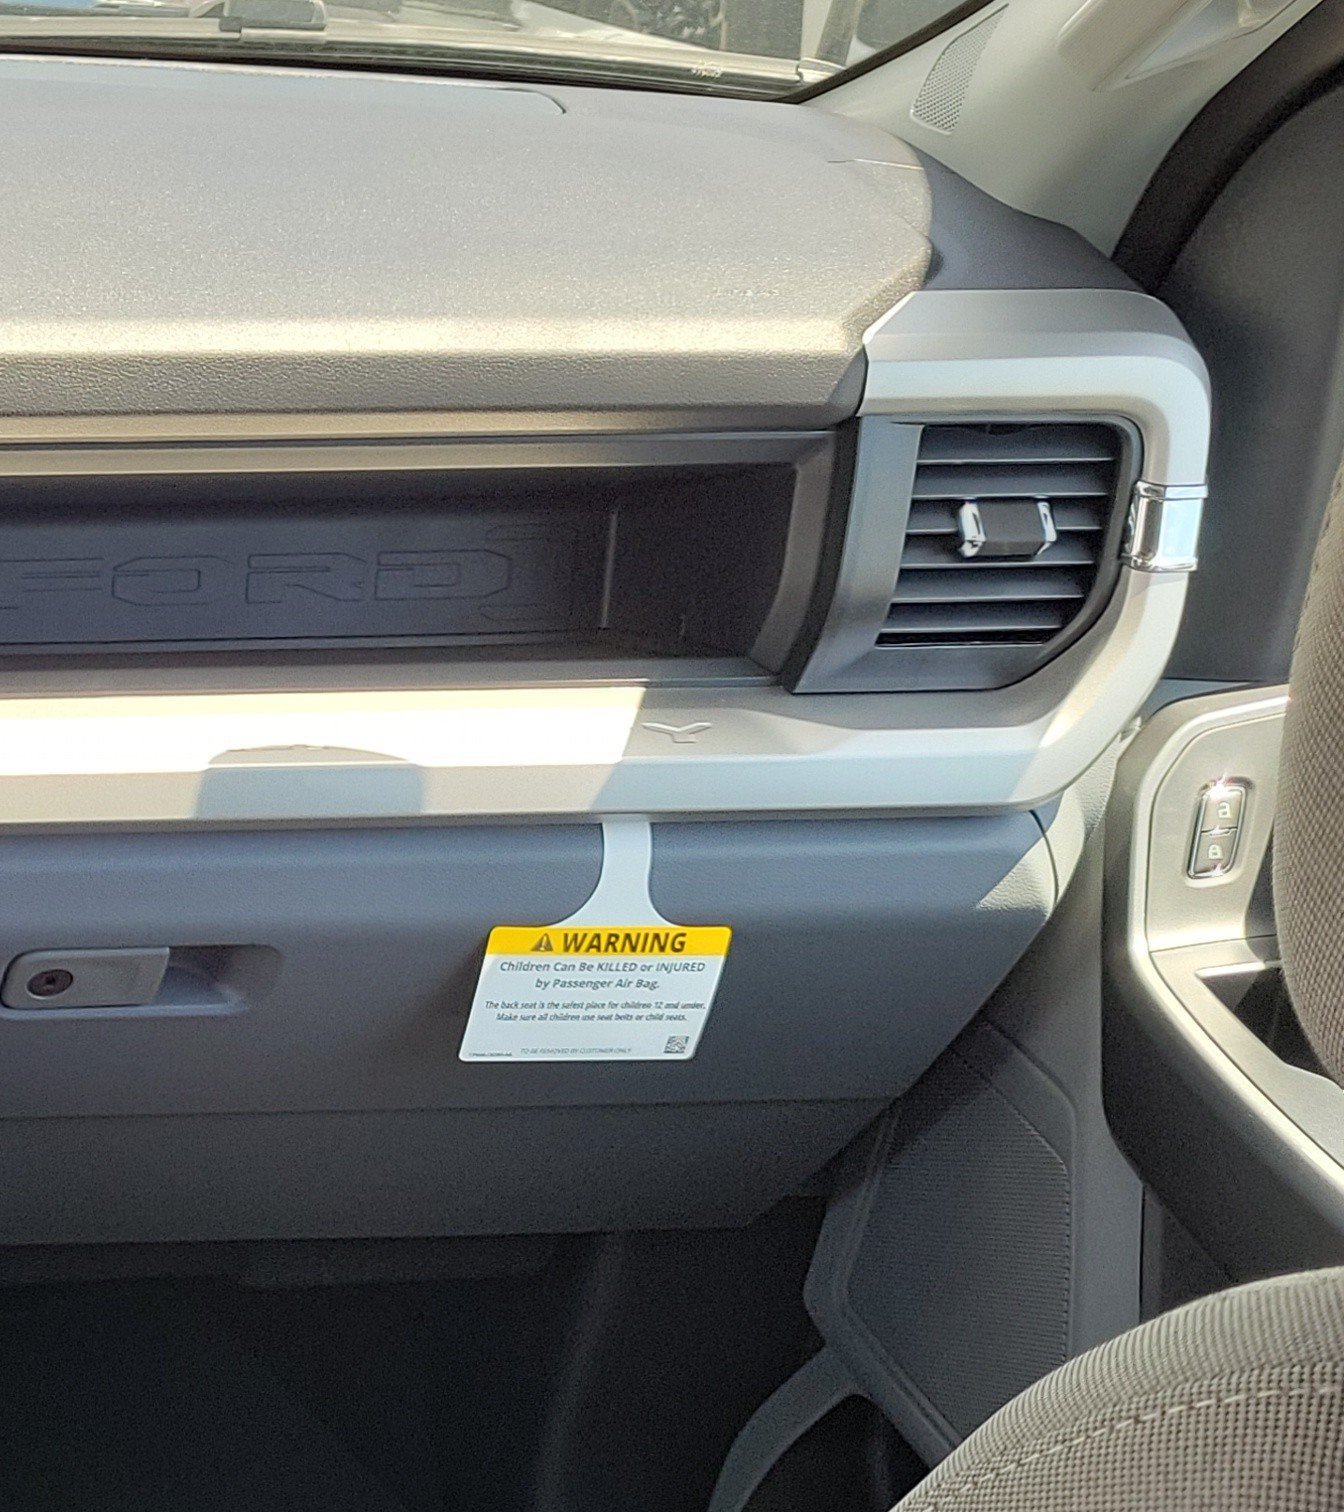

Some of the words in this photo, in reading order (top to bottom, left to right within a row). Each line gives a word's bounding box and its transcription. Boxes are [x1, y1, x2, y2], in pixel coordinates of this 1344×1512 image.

[562, 932, 687, 953] WARNING
[500, 961, 550, 972] Children
[553, 962, 577, 972] Can
[579, 962, 594, 972] Be
[596, 962, 637, 972] KILLED
[639, 964, 654, 972] or
[656, 962, 706, 973] INJURED
[534, 979, 550, 990] by
[553, 979, 613, 990] Passenger
[615, 979, 633, 989] Air
[635, 979, 660, 990] Bag.
[485, 1001, 499, 1009] The
[501, 1001, 518, 1010] back
[521, 1001, 537, 1009] seat
[547, 1001, 560, 1009] the
[562, 1001, 584, 1009] safest
[585, 1001, 606, 1011] place
[608, 1001, 620, 1009] for
[620, 1001, 652, 1009] children
[664, 1001, 679, 1009] and
